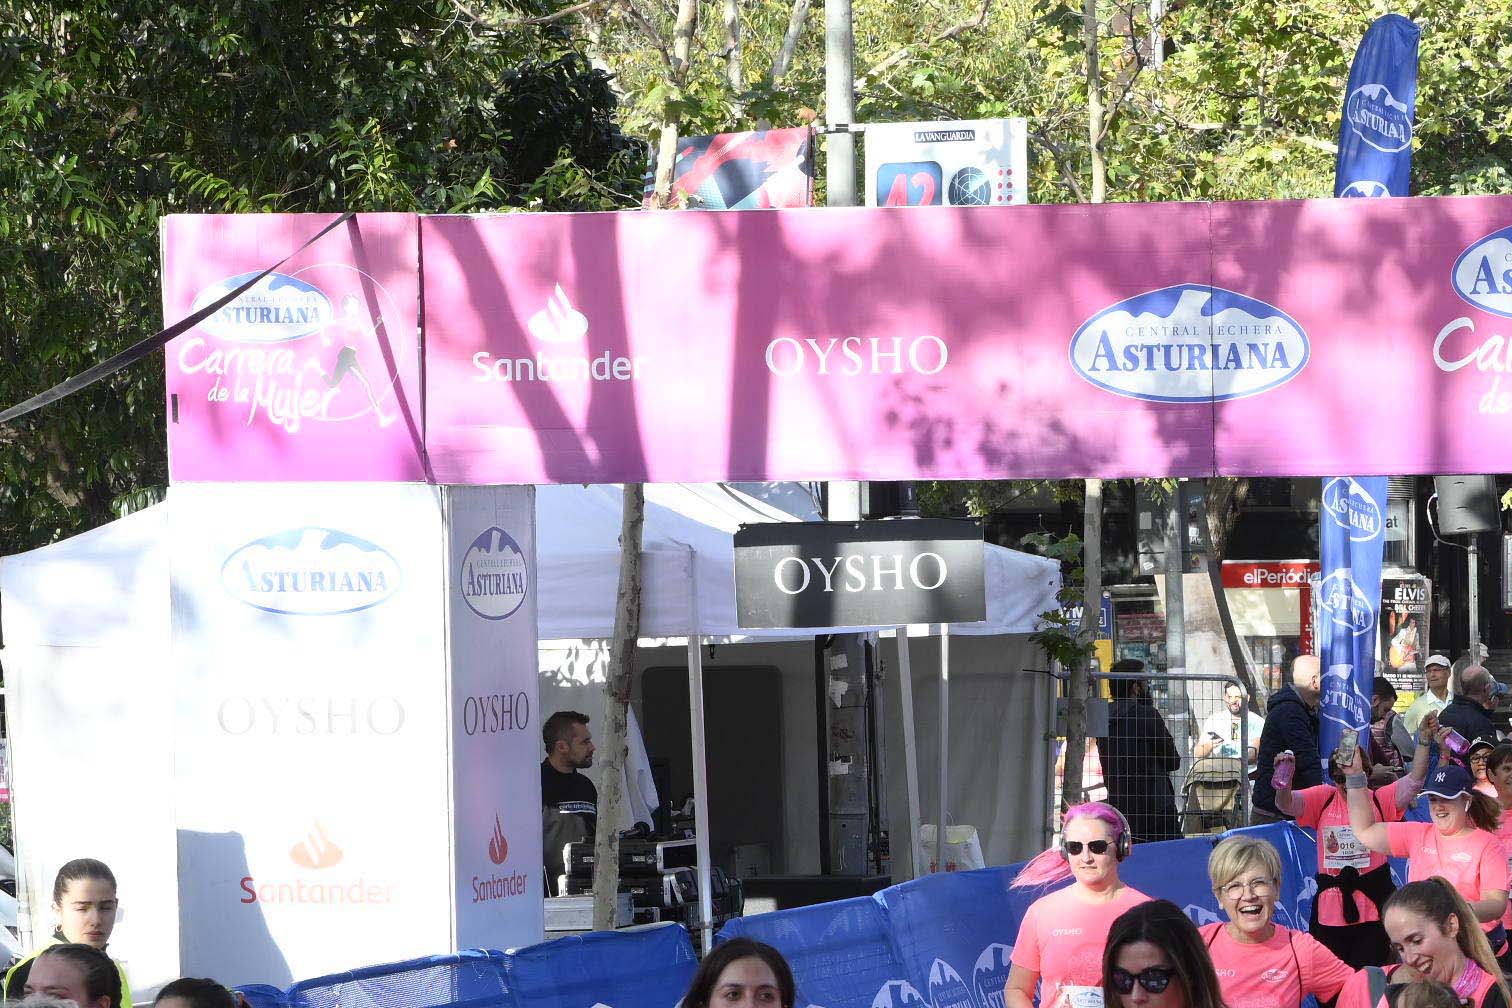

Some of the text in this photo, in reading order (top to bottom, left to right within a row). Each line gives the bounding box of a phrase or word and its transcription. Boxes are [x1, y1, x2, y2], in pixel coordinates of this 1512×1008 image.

[925, 130, 975, 142] VANGUARDIA
[1125, 325, 1284, 337] CENTRAL LECHERA
[178, 337, 295, 375] Carrera
[472, 350, 641, 382] Santander
[766, 336, 949, 376] OYSHO
[1088, 329, 1291, 372] ASTURIANA
[207, 377, 229, 403] de
[246, 374, 342, 434] Mujer
[241, 559, 389, 593] ASTURIANA
[466, 562, 525, 597] ASTURIANA
[774, 551, 948, 595] OYSHO
[1394, 587, 1426, 601] ELVIS
[216, 697, 406, 736] OYSHO
[463, 691, 530, 736] OYSHO
[240, 877, 395, 905] Santander
[472, 869, 527, 904] Santander
